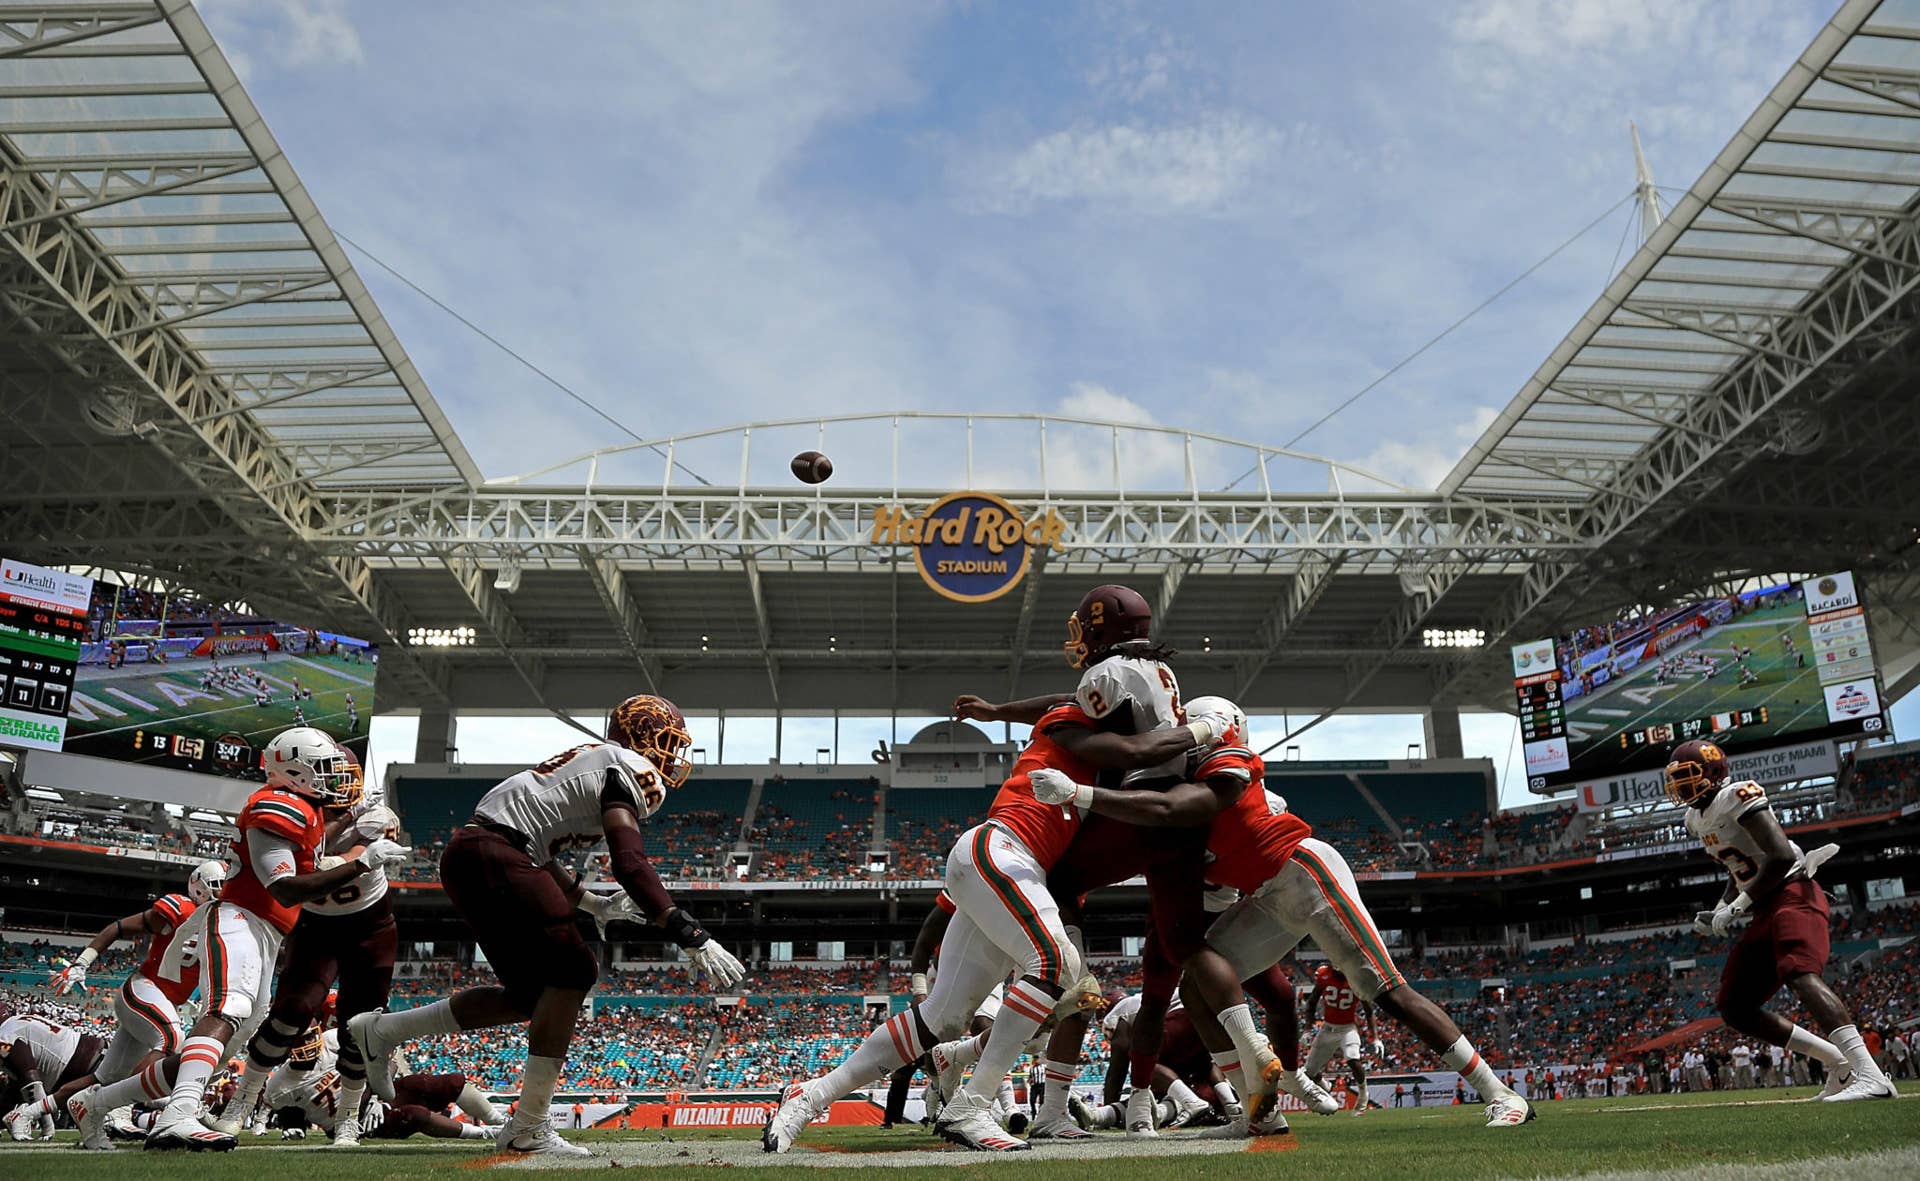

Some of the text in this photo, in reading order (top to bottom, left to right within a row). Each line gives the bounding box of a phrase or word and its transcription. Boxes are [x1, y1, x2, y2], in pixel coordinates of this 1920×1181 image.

[871, 506, 1066, 553] Hard Rock
[937, 560, 1008, 574] STADIUM
[18, 689, 29, 702] 11
[50, 695, 57, 706] 1
[1089, 691, 1107, 716] 2
[0, 717, 60, 735] STRELLA
[1681, 719, 1702, 733] 3:47
[1865, 719, 1881, 729] CC
[0, 726, 60, 743] SURANCE
[153, 735, 167, 749] 13
[1634, 733, 1645, 744] 13
[217, 742, 242, 757] 3:47
[1772, 752, 1786, 764] OF
[1789, 745, 1826, 761] MIAMI
[1752, 765, 1796, 780] SYSTEM
[1735, 783, 1763, 802] 83
[1324, 985, 1354, 1010] 22
[314, 1071, 335, 1092] BCU
[673, 1107, 731, 1126] MIAMI
